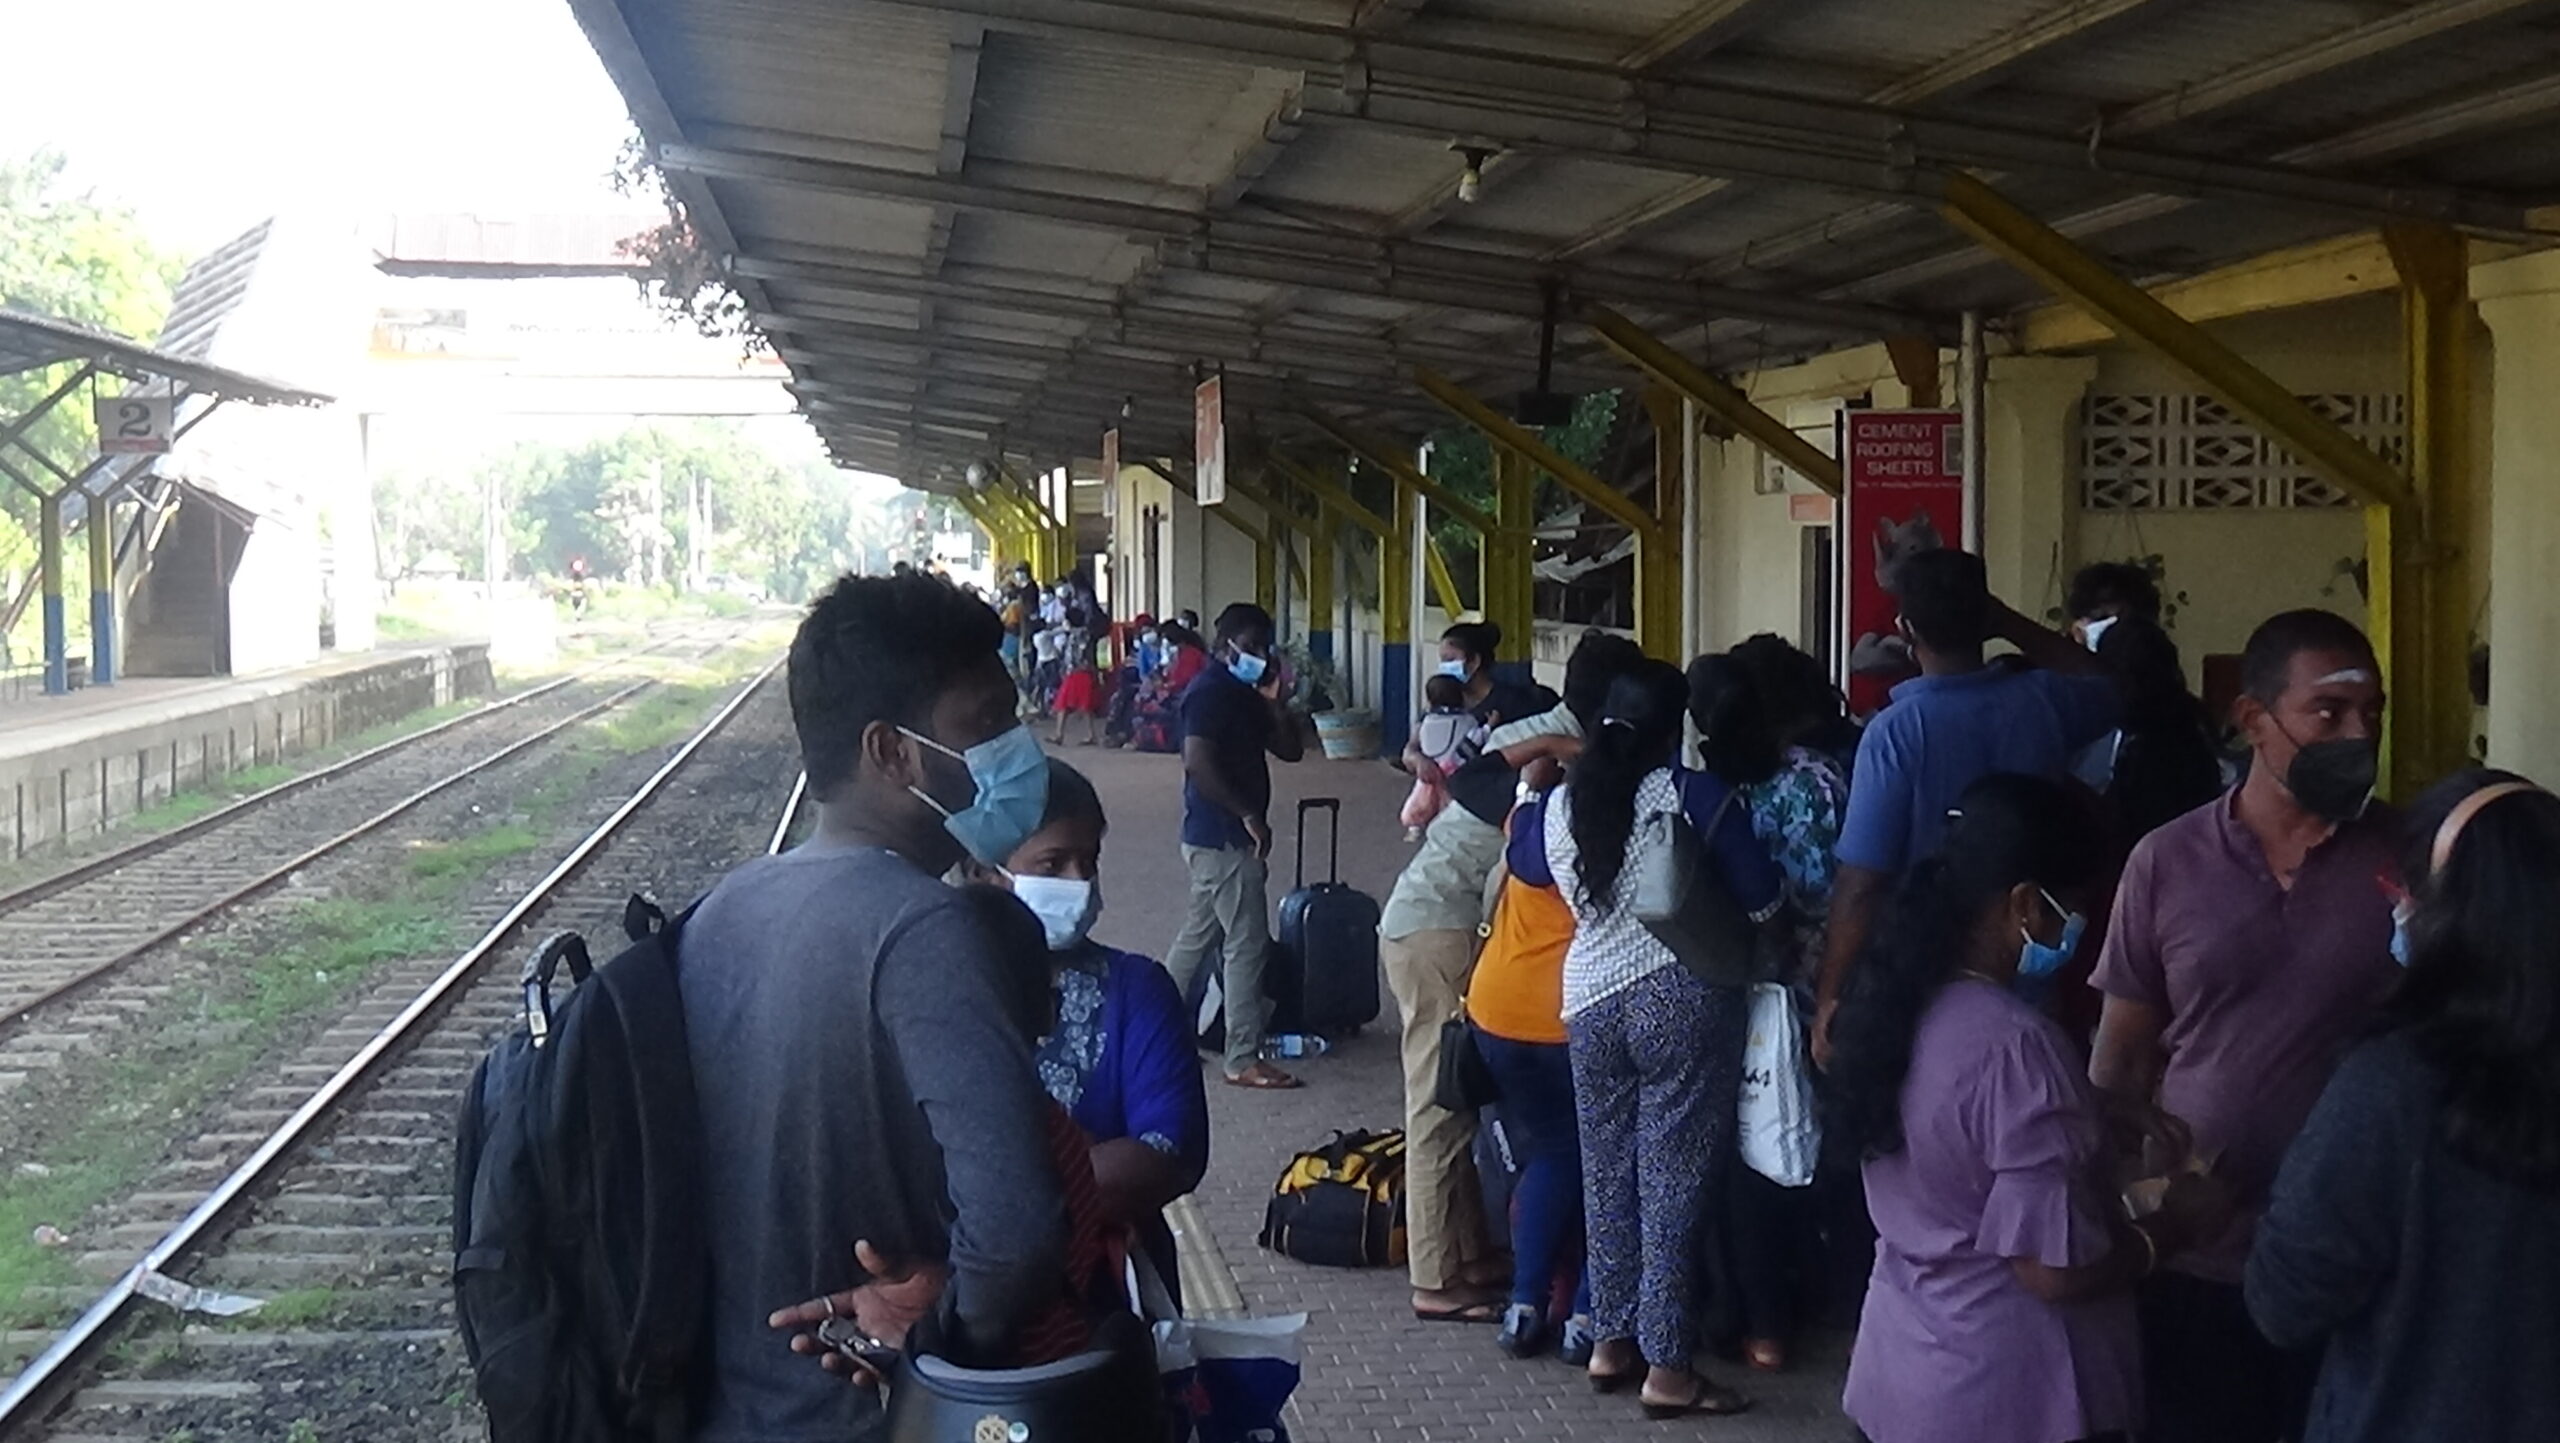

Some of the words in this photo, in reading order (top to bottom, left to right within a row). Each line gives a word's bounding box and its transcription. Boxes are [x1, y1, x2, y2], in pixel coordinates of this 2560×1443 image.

[118, 402, 152, 437] 2
[1858, 423, 1932, 438] CEMENT
[1856, 442, 1935, 457] ROOFING
[1866, 461, 1935, 476] SHEETS
